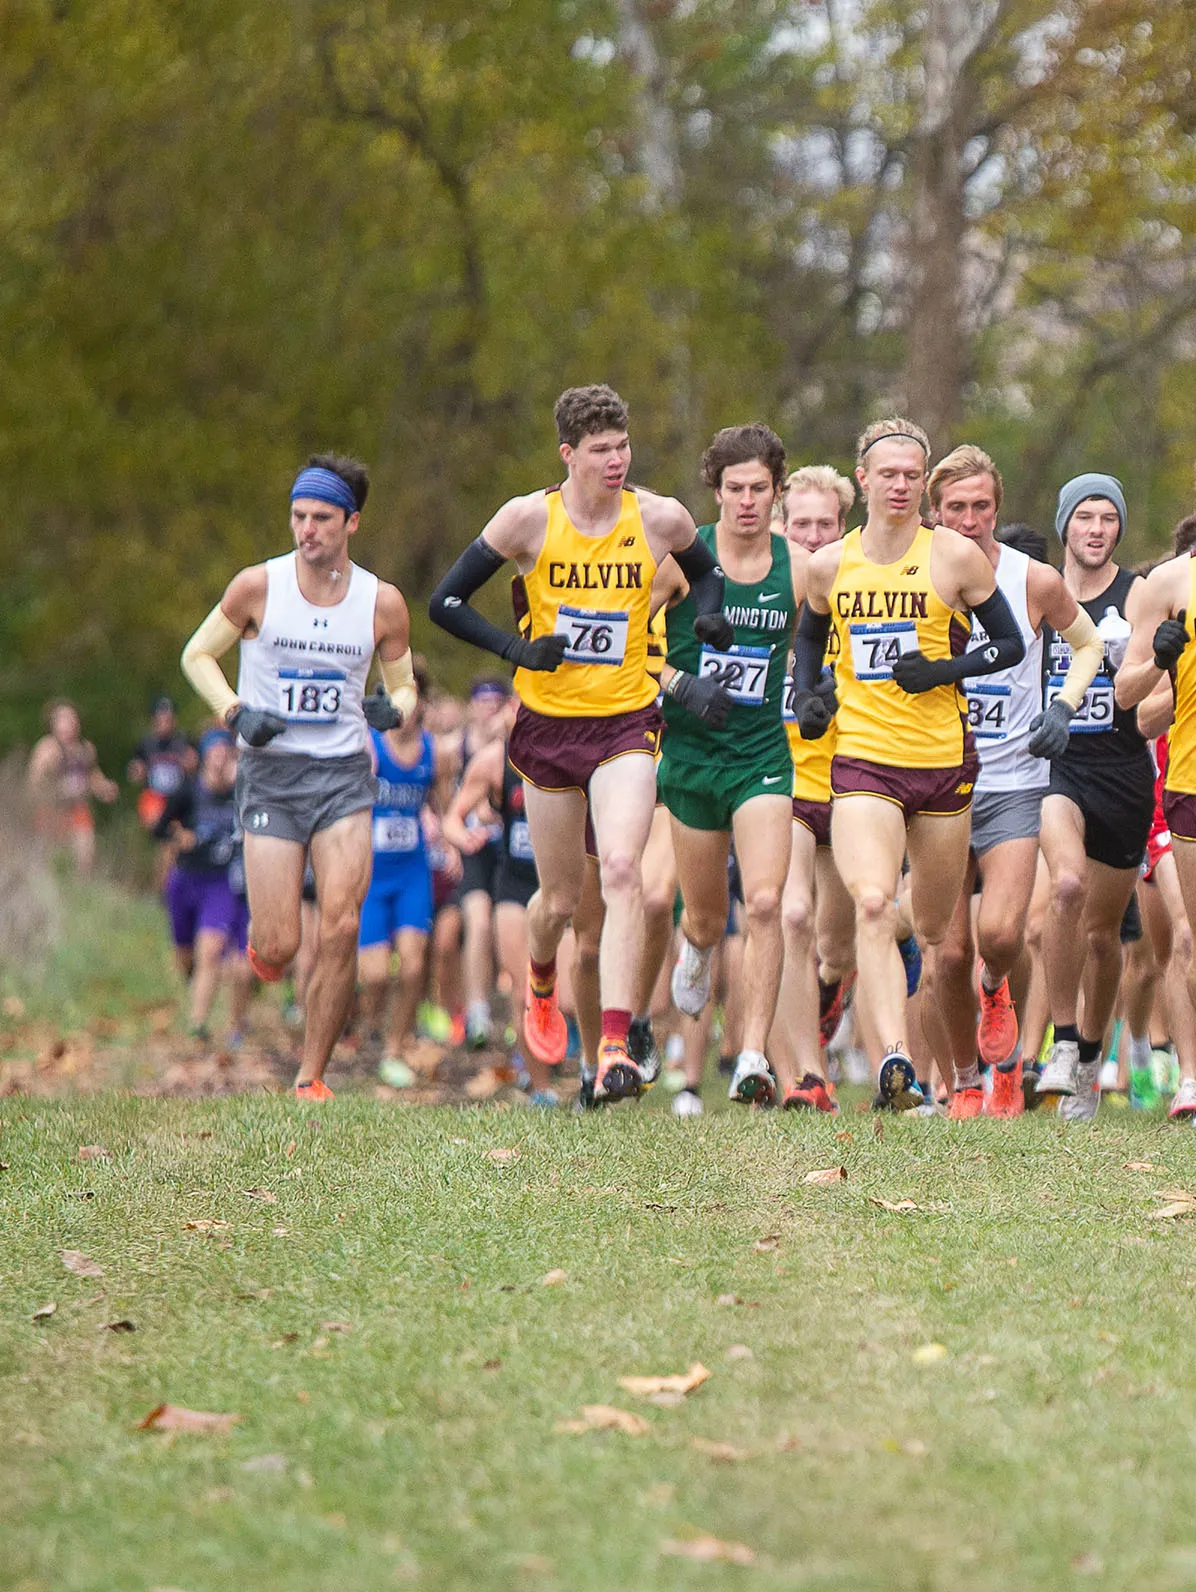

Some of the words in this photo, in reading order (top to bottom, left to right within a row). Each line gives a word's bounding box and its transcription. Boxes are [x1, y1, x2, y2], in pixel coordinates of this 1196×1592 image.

[549, 562, 643, 589] CALVIN
[724, 605, 788, 631] MINGTON
[837, 590, 929, 618] CALVIN
[273, 637, 307, 650] JOHN
[309, 641, 363, 656] CARROLL
[571, 622, 614, 653] 76
[862, 638, 901, 669] 74
[282, 683, 341, 713] 183
[967, 697, 1006, 728] 84
